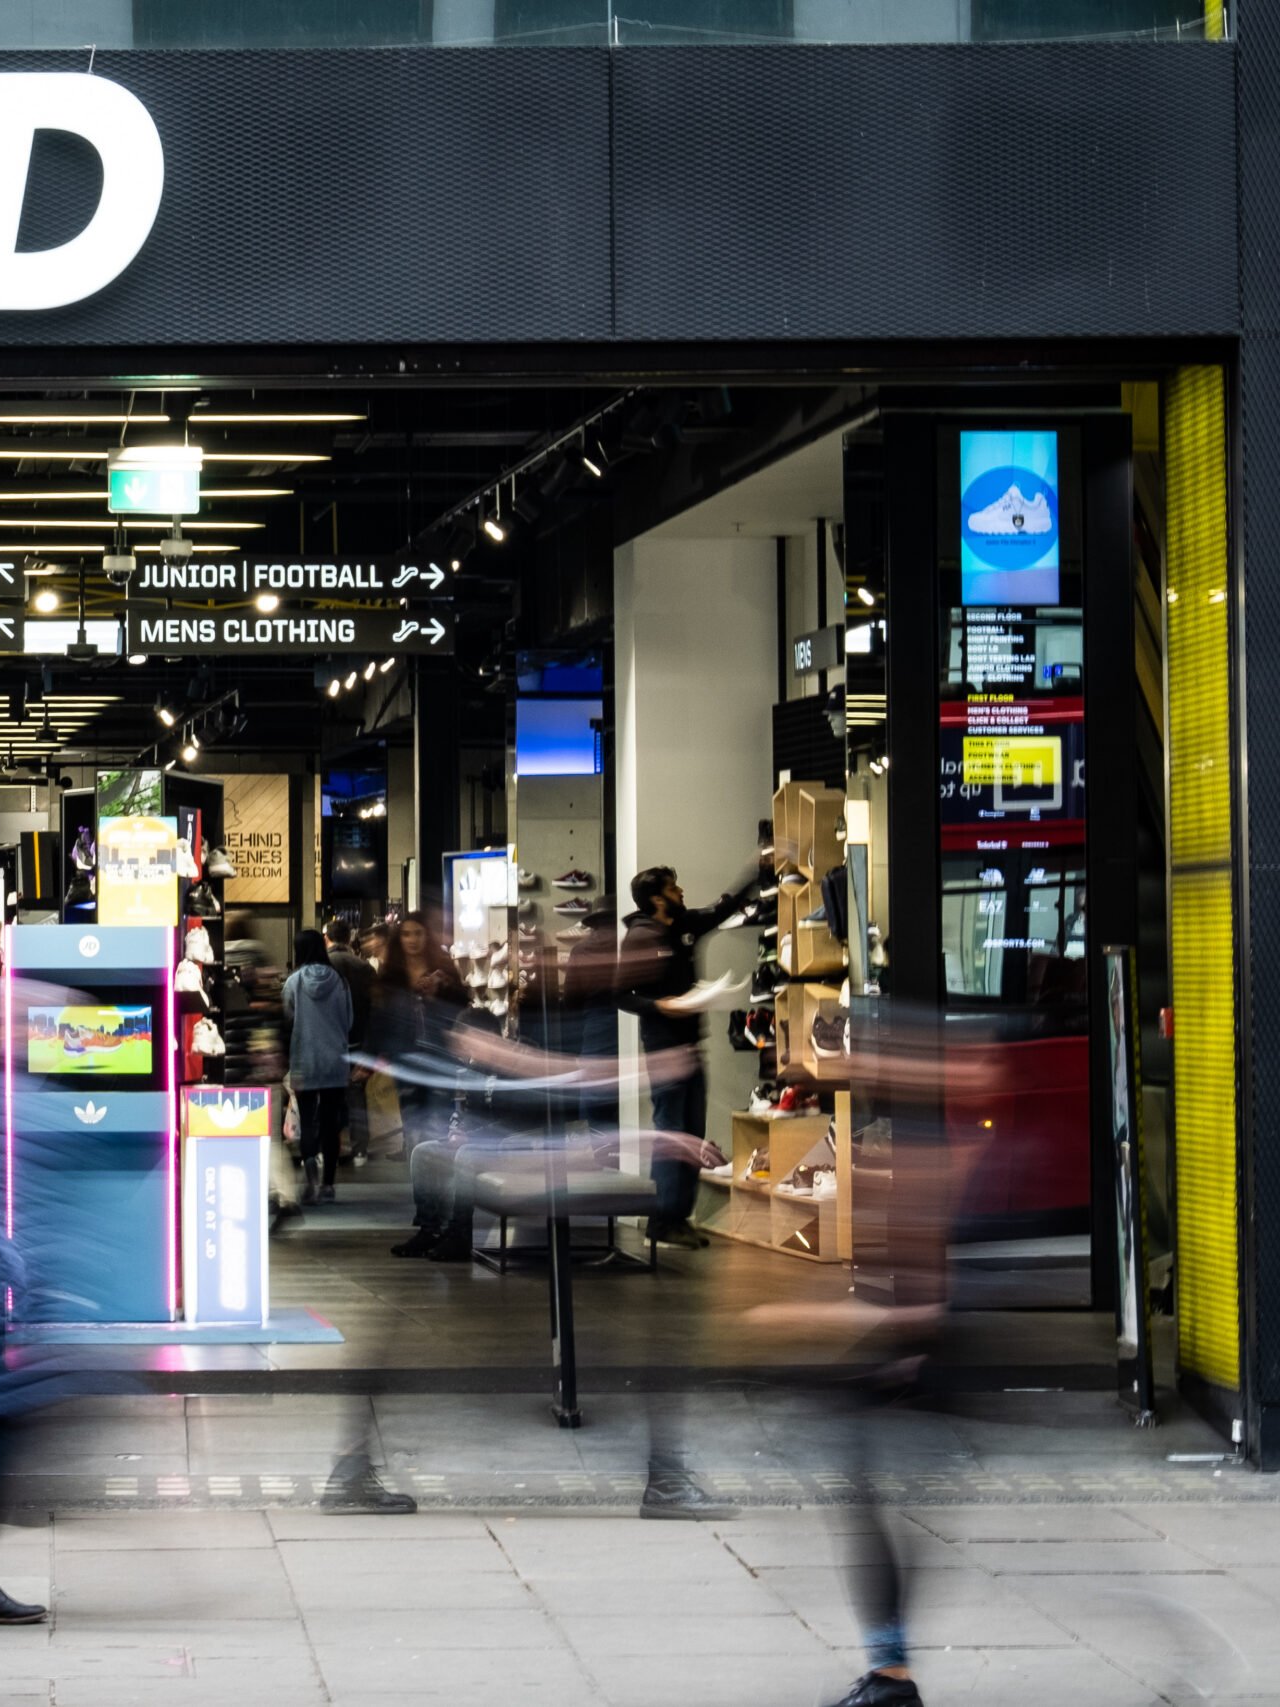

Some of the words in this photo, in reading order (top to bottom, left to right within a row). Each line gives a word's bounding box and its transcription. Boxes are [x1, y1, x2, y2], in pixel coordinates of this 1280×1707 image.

[139, 564, 236, 588] JUNIOR
[254, 564, 383, 588] FOOTBALL
[140, 619, 216, 643] MENS
[223, 619, 356, 643] CLOTHING
[224, 832, 282, 848] EHIND
